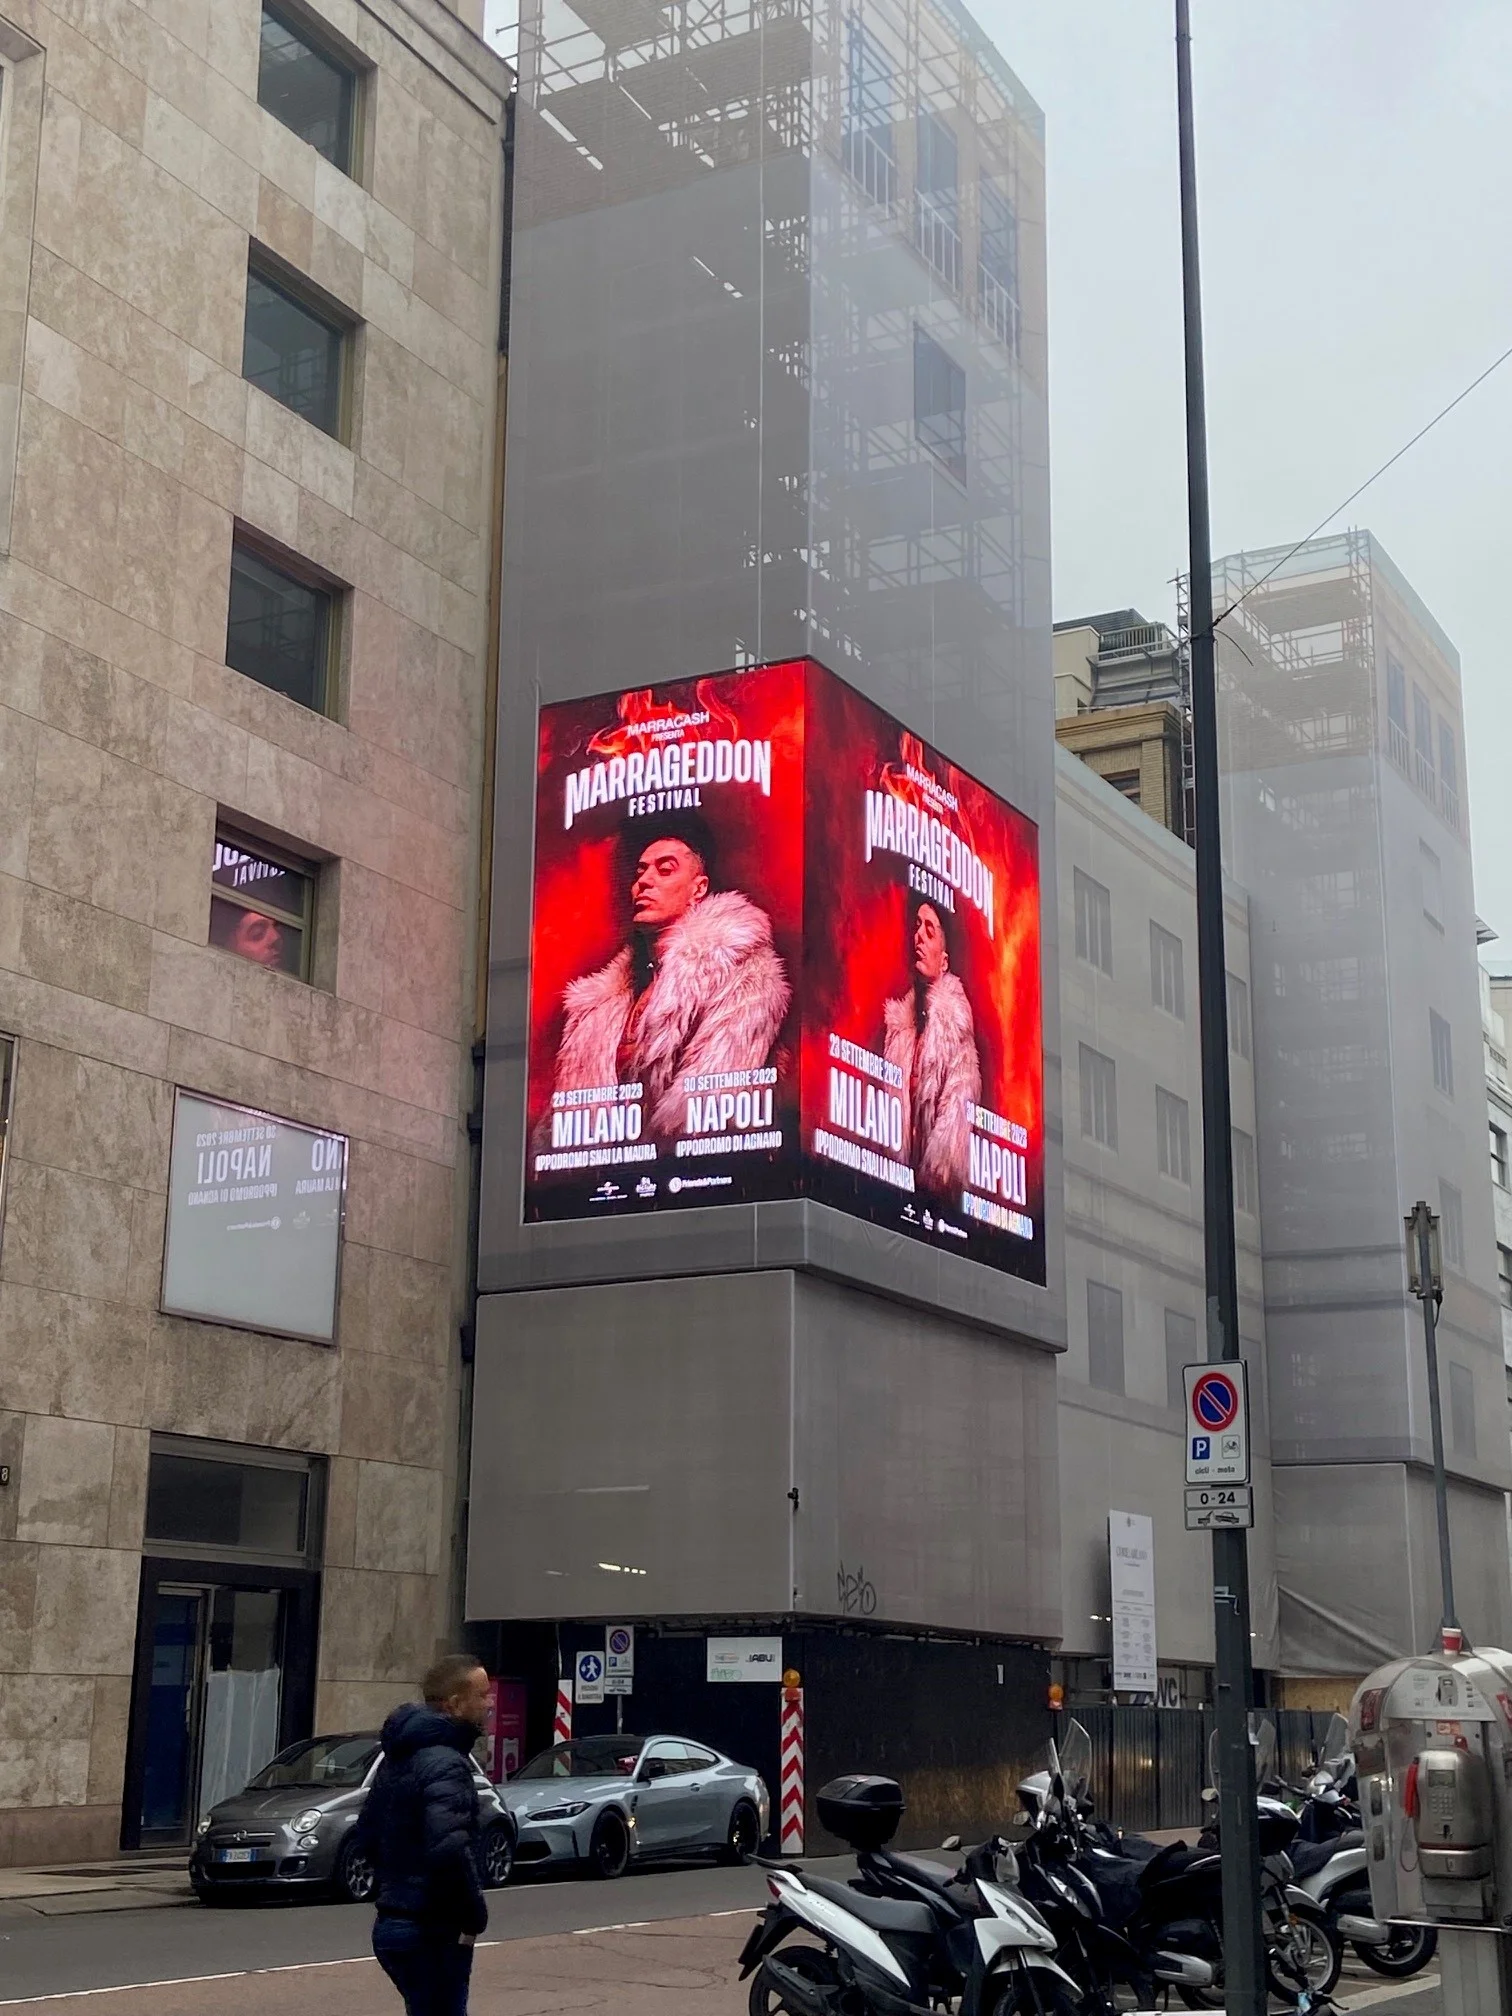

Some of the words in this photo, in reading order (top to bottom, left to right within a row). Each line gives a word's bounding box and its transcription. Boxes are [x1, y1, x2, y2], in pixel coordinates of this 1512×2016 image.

[627, 711, 710, 736] MARRACASH
[564, 739, 771, 830] MARRAGEDDON
[628, 787, 702, 817] FESTIVAL
[906, 763, 958, 812] MARRACASH
[865, 790, 994, 940] MARRAGEDDON
[908, 863, 955, 913] FESTIVAL
[684, 1077, 696, 1092] 30
[697, 1070, 751, 1091] SETTEMBRE
[752, 1067, 778, 1085] 2023
[829, 1033, 840, 1059] 23
[841, 1038, 883, 1079] SETTEMBRE
[884, 1060, 903, 1089] 2023
[552, 1091, 565, 1107] 23
[566, 1087, 619, 1106] SETTEMBRE
[619, 1082, 643, 1100] 2023
[686, 1088, 773, 1134] NAPOLI
[830, 1067, 902, 1152] MILANO
[552, 1103, 642, 1148] MILANO
[676, 1135, 732, 1158] IPPODROMO
[732, 1134, 743, 1152] DI
[743, 1130, 782, 1151] AGNANO
[535, 1151, 588, 1172] IPPODROMO
[611, 1146, 623, 1164] LA
[623, 1143, 657, 1163] MAURA
[969, 1131, 1027, 1206] NAPOLI
[1196, 1440, 1207, 1458] P
